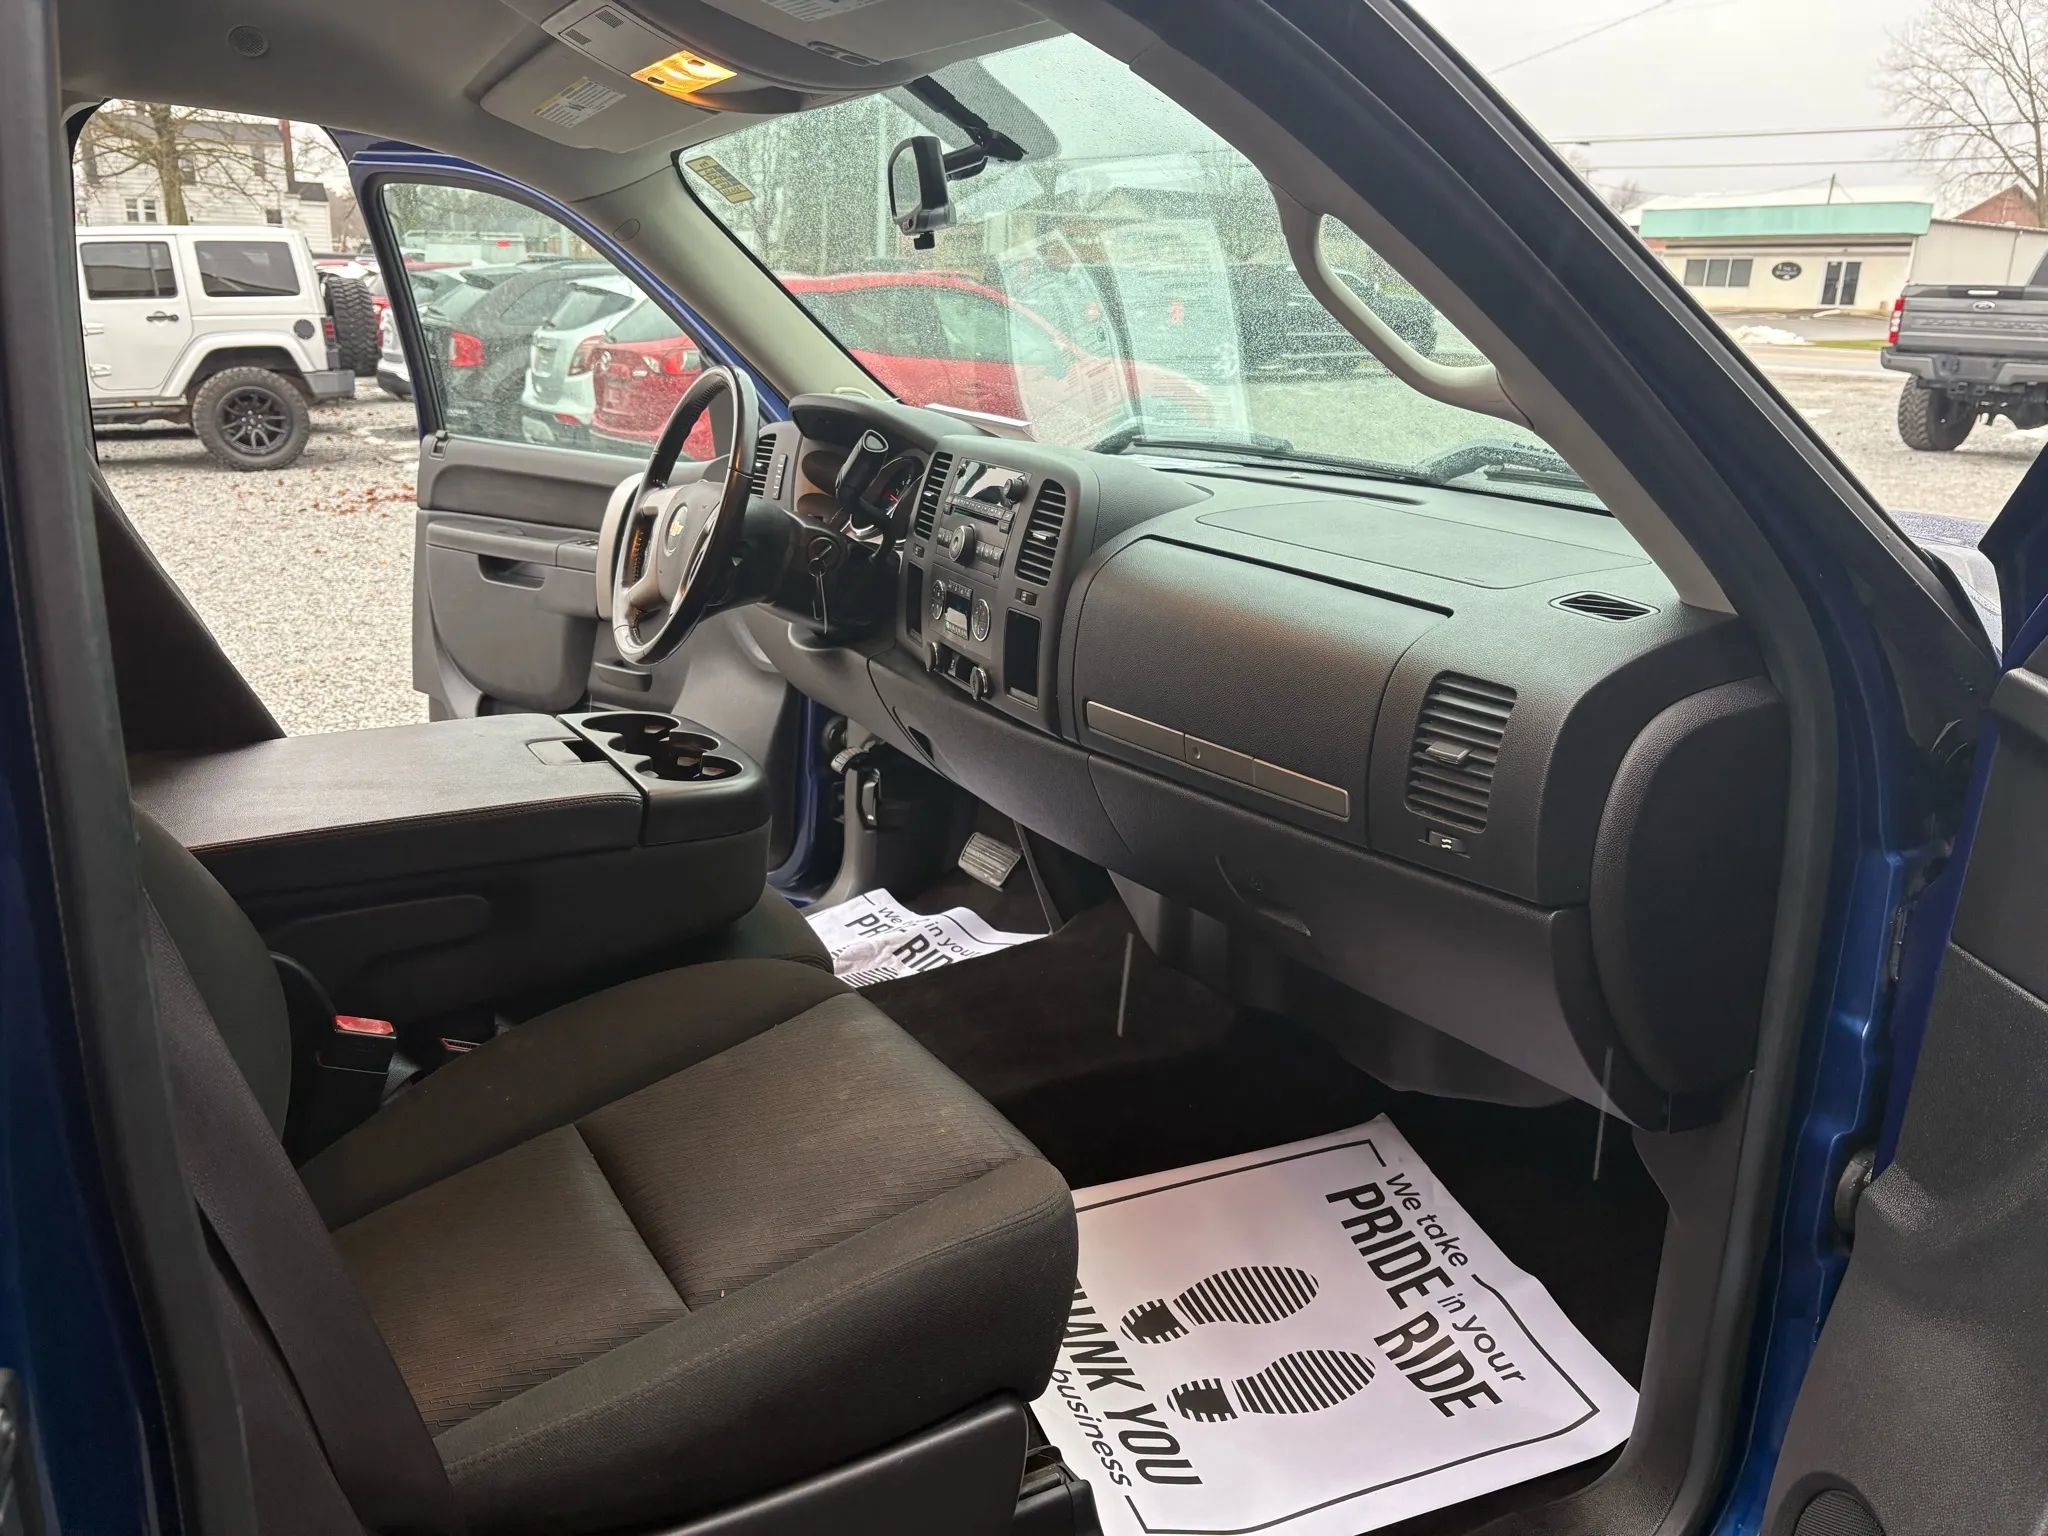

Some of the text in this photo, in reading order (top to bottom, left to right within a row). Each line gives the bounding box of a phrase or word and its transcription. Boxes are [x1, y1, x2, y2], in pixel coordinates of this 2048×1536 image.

[878, 907, 902, 924] We
[924, 921, 943, 937] in
[1325, 1182, 1455, 1310] PRIDE
[1386, 1172, 1468, 1267] We take
[1373, 1311, 1503, 1418] RIDE
[1437, 1293, 1526, 1382] in your
[1051, 1368, 1132, 1487] business
[1103, 1402, 1203, 1484] YOU
